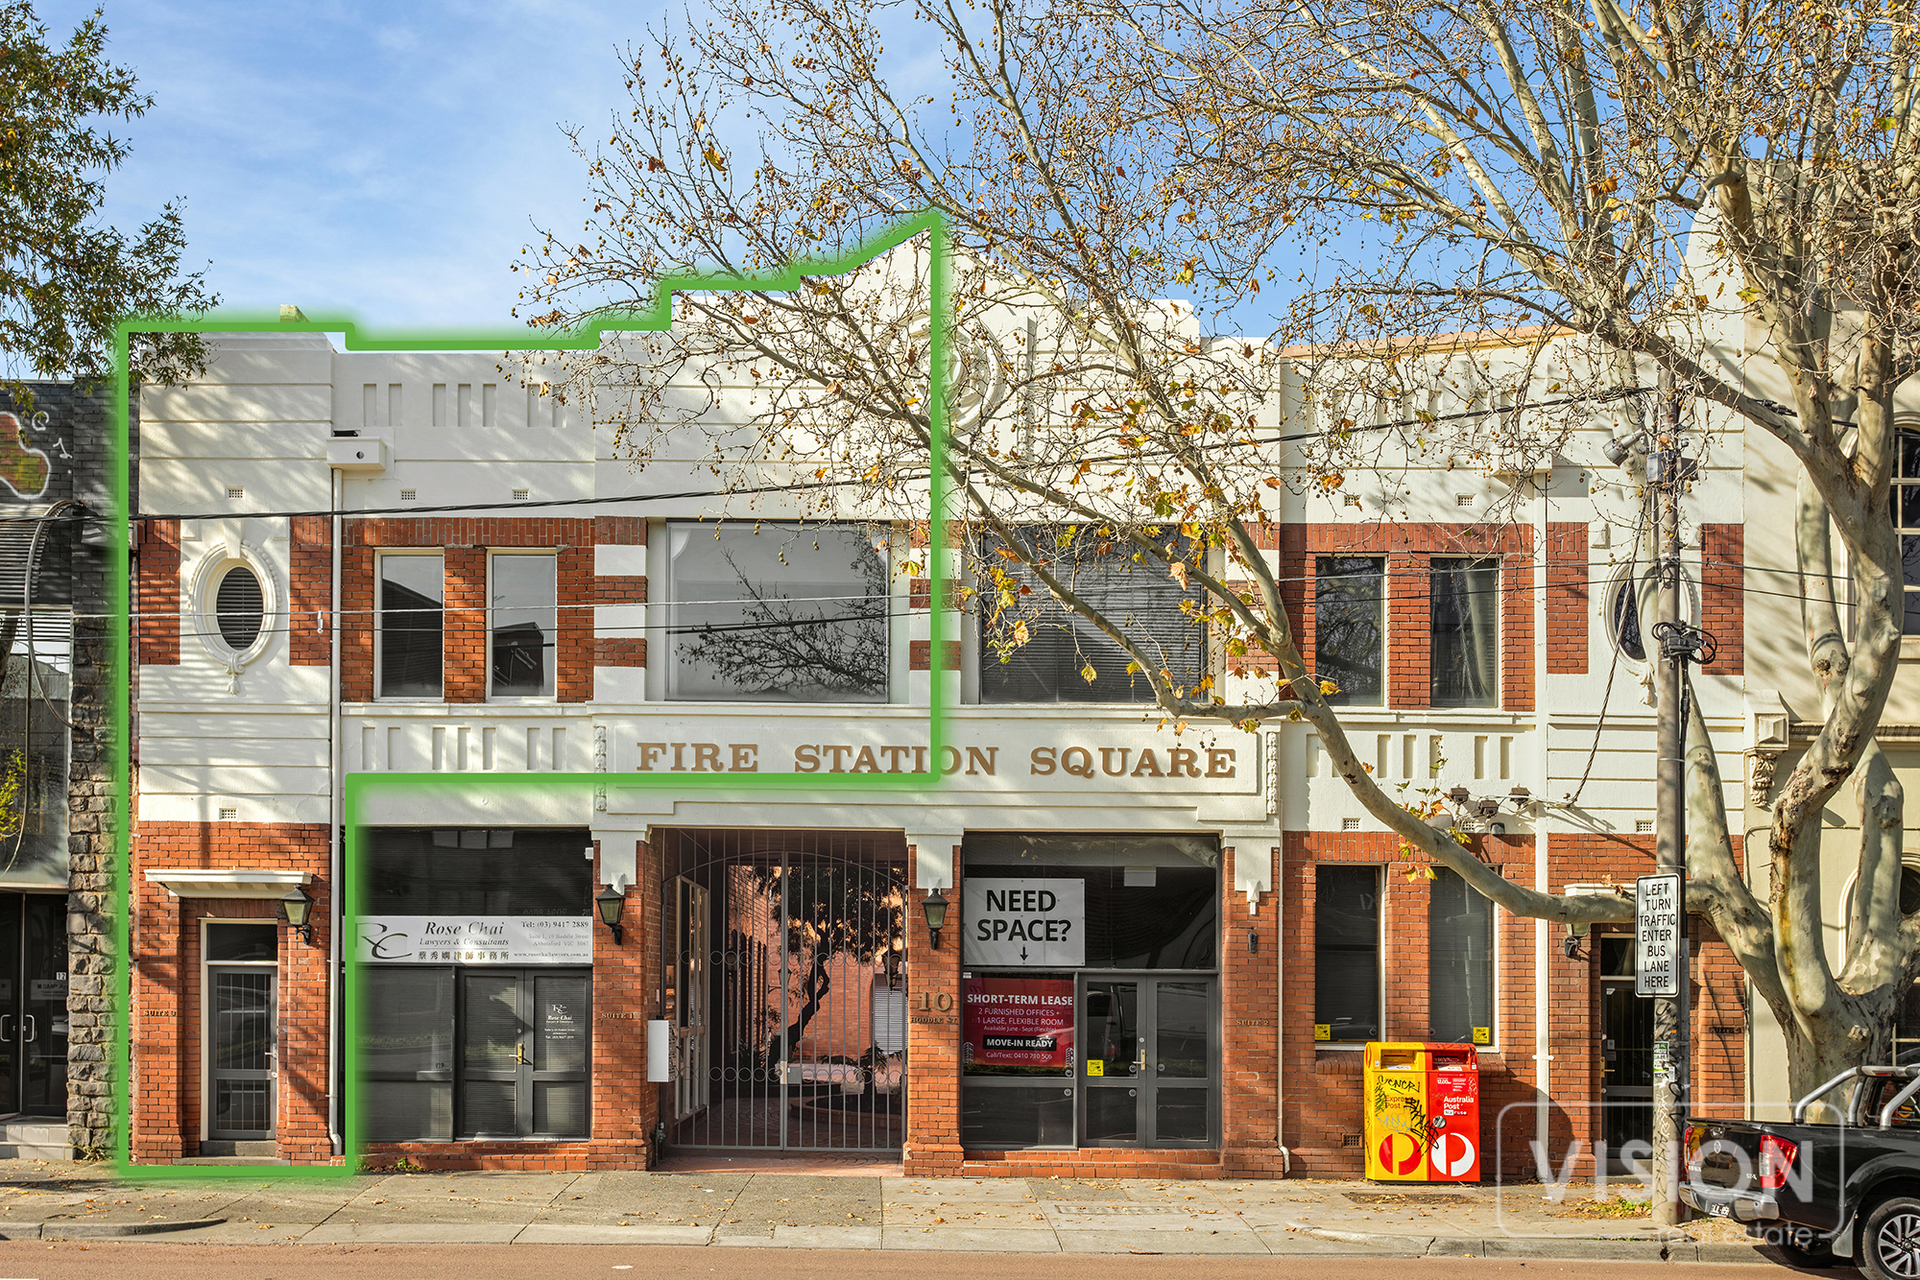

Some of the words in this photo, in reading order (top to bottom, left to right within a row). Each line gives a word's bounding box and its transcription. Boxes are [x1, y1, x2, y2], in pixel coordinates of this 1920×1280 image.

[636, 742, 759, 772] FIRE
[793, 744, 999, 776] STATION
[1029, 747, 1237, 779] SQUARE
[1646, 883, 1669, 896] LEFT
[986, 890, 1057, 912] NEED
[1646, 899, 1671, 911] TURN
[537, 921, 551, 929] (03)
[1639, 914, 1676, 927] TRAFFIC
[425, 921, 462, 936] Rose
[468, 921, 505, 936] Chai
[977, 919, 1072, 942] SPACE?
[1642, 929, 1672, 942] ENTER
[419, 938, 451, 947] Lawyers
[463, 938, 509, 946] Consultants
[1647, 945, 1666, 957] BUS
[1644, 961, 1669, 973] LANE
[1644, 976, 1669, 988] HERE
[919, 992, 952, 1011] 10
[967, 994, 1038, 1005] SHORT-TERM
[1041, 996, 1073, 1006] LEASE
[985, 1008, 1025, 1016] FURNISHED
[1026, 1009, 1055, 1017] OFFICES
[983, 1017, 1008, 1025] LARGE,
[1041, 1018, 1064, 1026] ROOM
[987, 1039, 1024, 1047] MOVE-IN
[1026, 1040, 1054, 1048] READY
[1386, 1095, 1413, 1104] Expre
